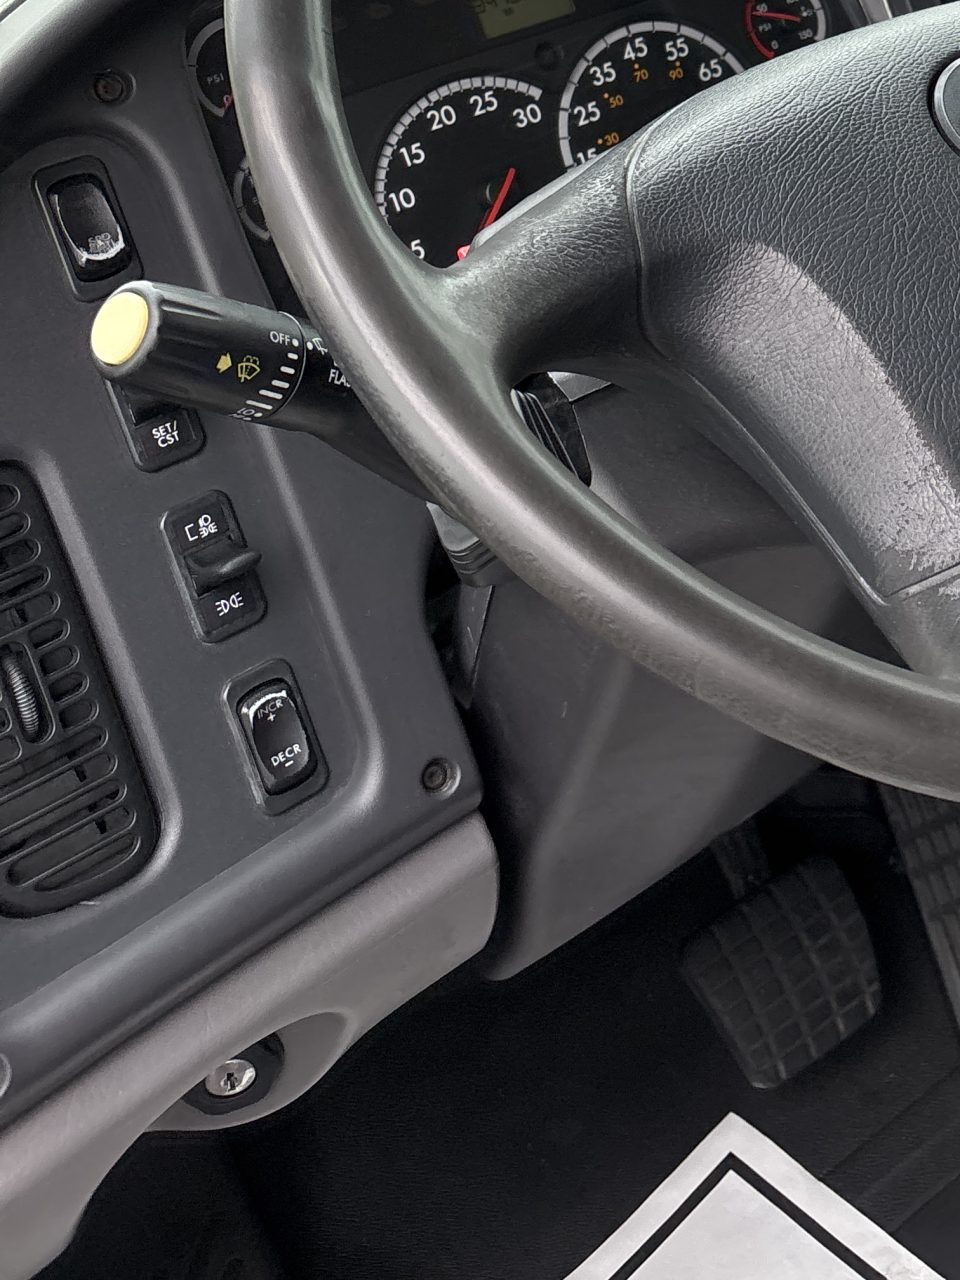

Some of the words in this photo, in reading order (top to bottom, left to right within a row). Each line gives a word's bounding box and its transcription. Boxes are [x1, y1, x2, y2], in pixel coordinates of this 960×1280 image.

[758, 23, 772, 33] PSI
[798, 29, 813, 41] 150
[623, 37, 648, 61] 45
[665, 37, 689, 62] 55
[206, 72, 225, 86] PSI
[589, 61, 616, 87] 35
[634, 68, 649, 83] 70
[668, 66, 684, 81] 90
[699, 58, 723, 82] 65
[469, 90, 498, 117] 25
[609, 94, 624, 109] 50
[426, 104, 457, 131] 20
[512, 103, 542, 128] 30
[573, 100, 601, 127] 25
[604, 131, 620, 147] 30
[399, 142, 426, 167] 15
[388, 187, 416, 212] 10
[410, 239, 425, 260] 5
[269, 330, 290, 346] OFF
[236, 407, 255, 416] LO
[151, 419, 177, 439] SET/
[157, 430, 179, 448] CST
[256, 699, 284, 719] INCR
[270, 743, 302, 767] DECR
